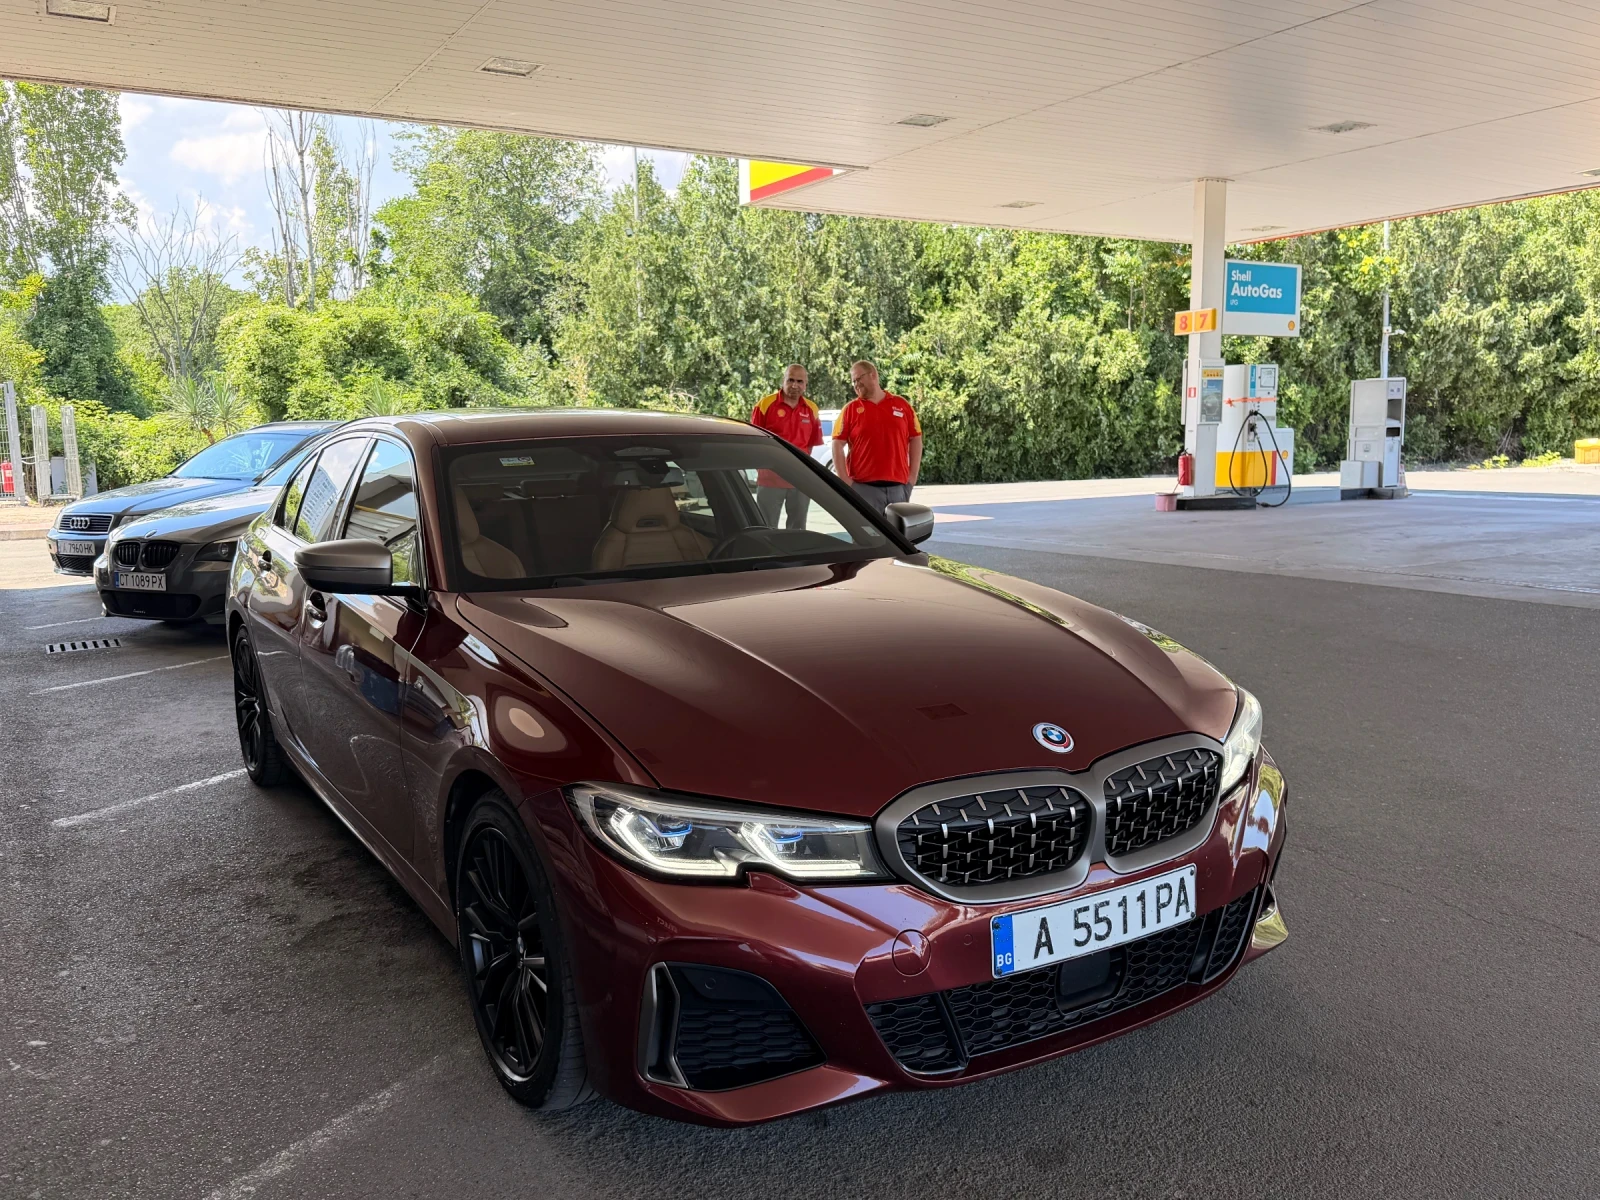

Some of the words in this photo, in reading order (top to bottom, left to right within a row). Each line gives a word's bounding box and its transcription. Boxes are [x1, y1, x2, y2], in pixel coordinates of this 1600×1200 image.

[1231, 270, 1252, 282] Shell
[1231, 282, 1283, 299] AutoGas
[1179, 315, 1188, 331] 8
[1199, 313, 1209, 329] 7
[120, 573, 129, 586] CT
[131, 574, 150, 588] 1089
[151, 575, 164, 589] PX
[1033, 916, 1055, 960] A
[1073, 889, 1147, 948] 5511
[1155, 876, 1190, 924] PA
[996, 952, 1013, 967] BG
